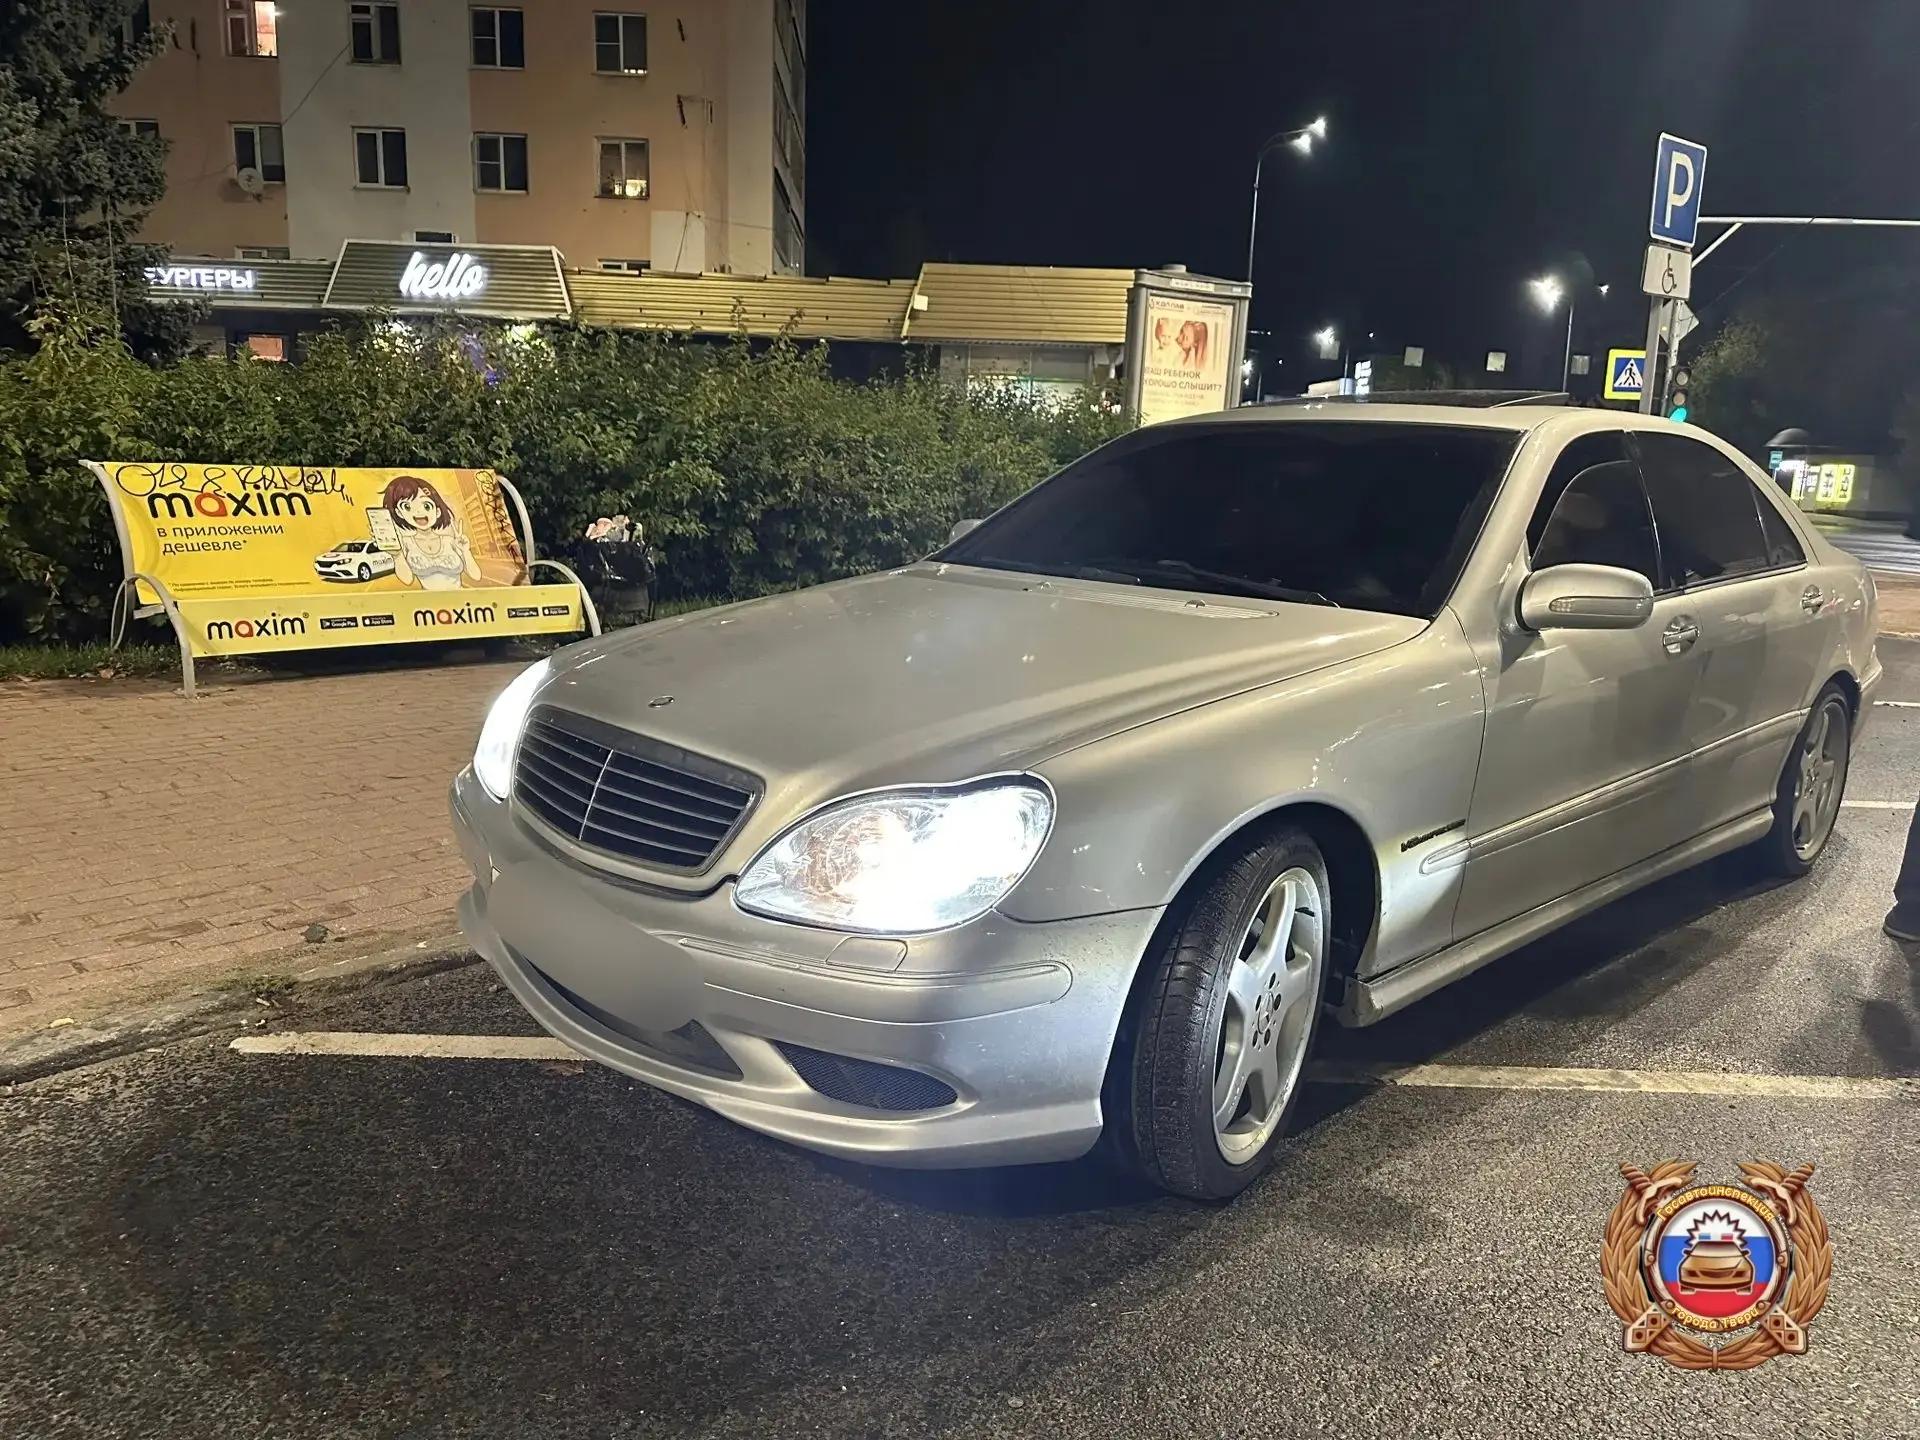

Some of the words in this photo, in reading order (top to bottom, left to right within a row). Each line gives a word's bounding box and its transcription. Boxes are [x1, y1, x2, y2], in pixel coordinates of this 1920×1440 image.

[1664, 150, 1695, 229] P
[399, 250, 484, 298] hello
[1163, 368, 1201, 379] РЕБЕНОК
[1178, 380, 1222, 392] СЛЫШИТ?
[147, 484, 312, 519] maxim
[157, 527, 168, 538] в
[172, 524, 285, 539] приложении
